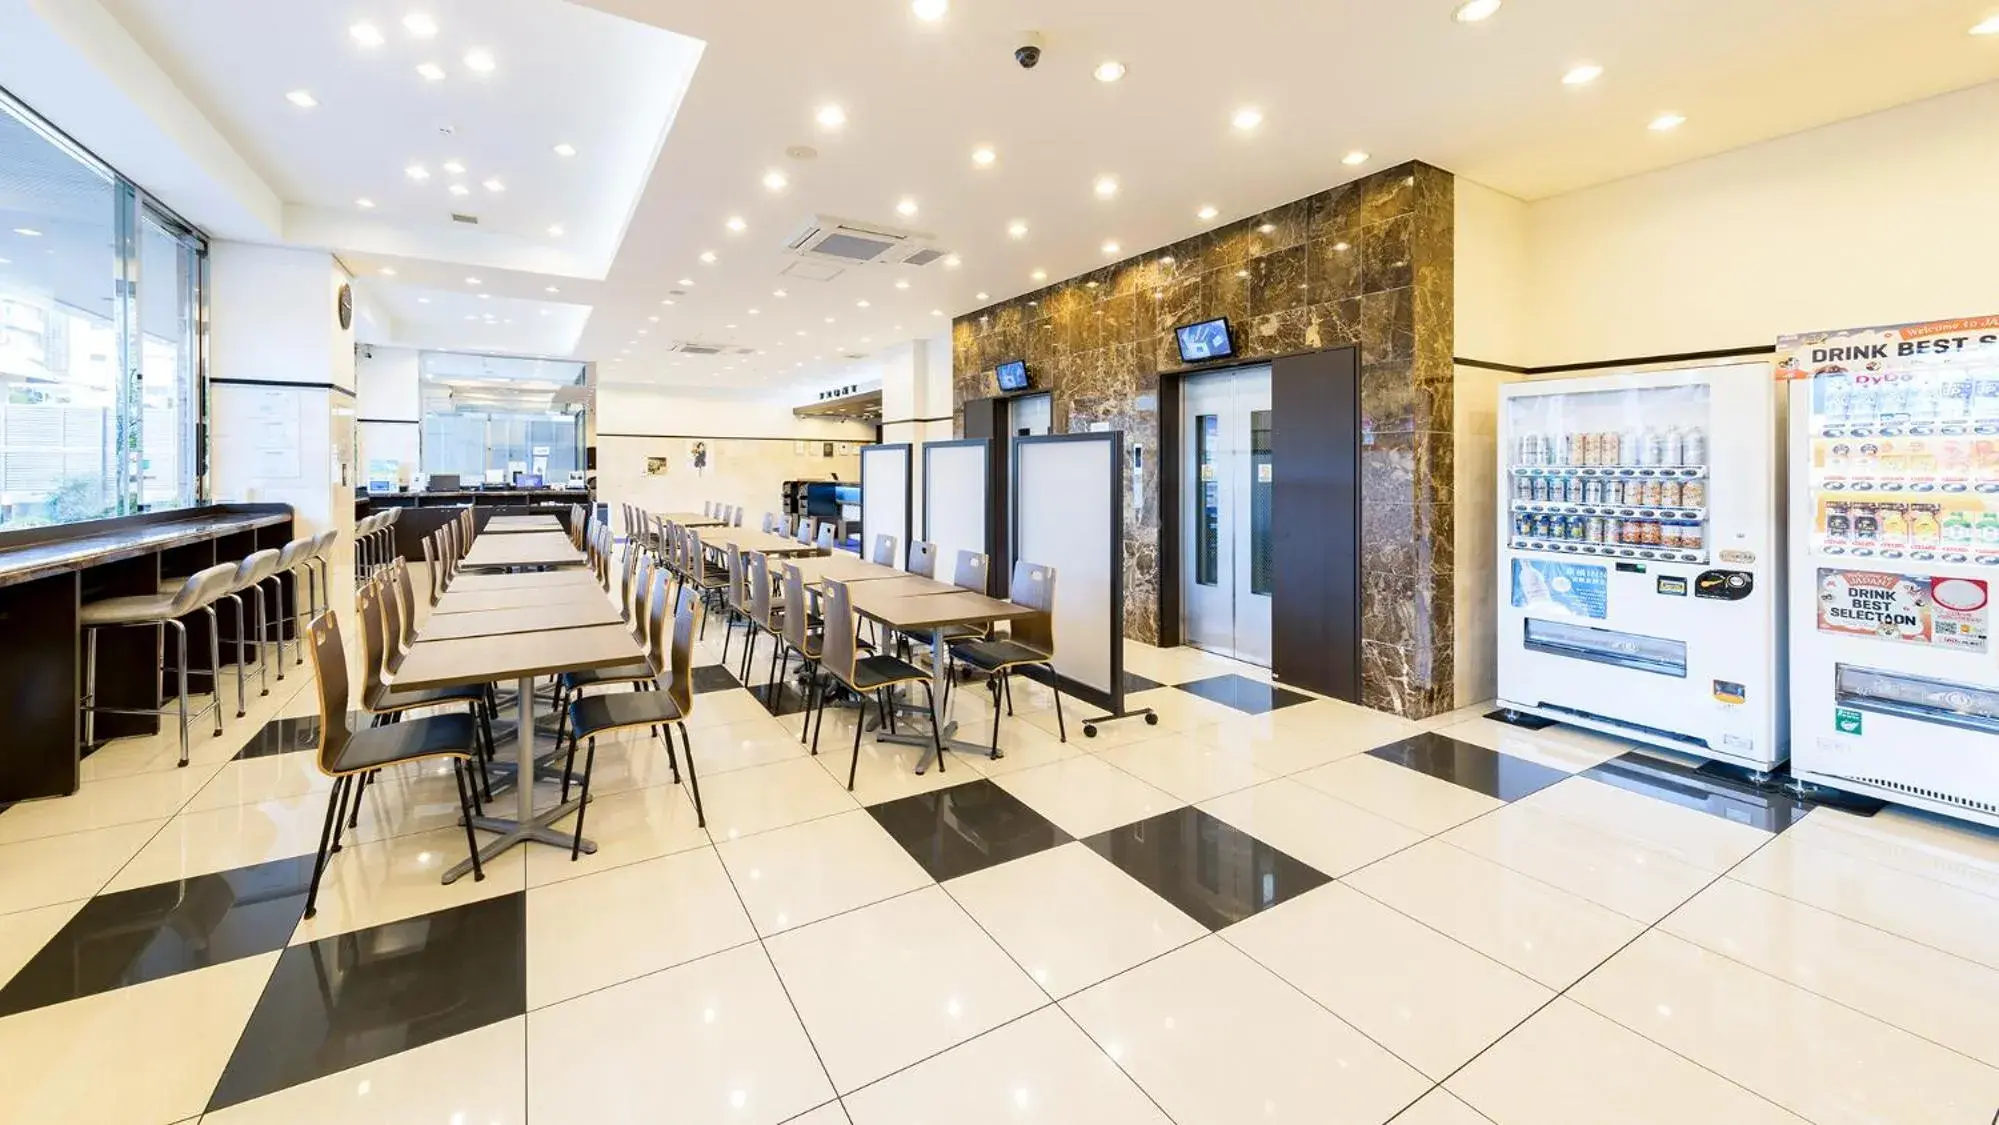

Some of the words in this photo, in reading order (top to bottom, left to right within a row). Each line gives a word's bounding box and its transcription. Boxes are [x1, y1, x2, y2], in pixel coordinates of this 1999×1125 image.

[1812, 343, 1888, 363] DRINK
[1897, 337, 1969, 357] BEST
[1856, 373, 1913, 385] DyDo
[1848, 588, 1896, 601] DRINK
[1852, 599, 1892, 611] BEST
[1830, 607, 1916, 626] SELECTON
